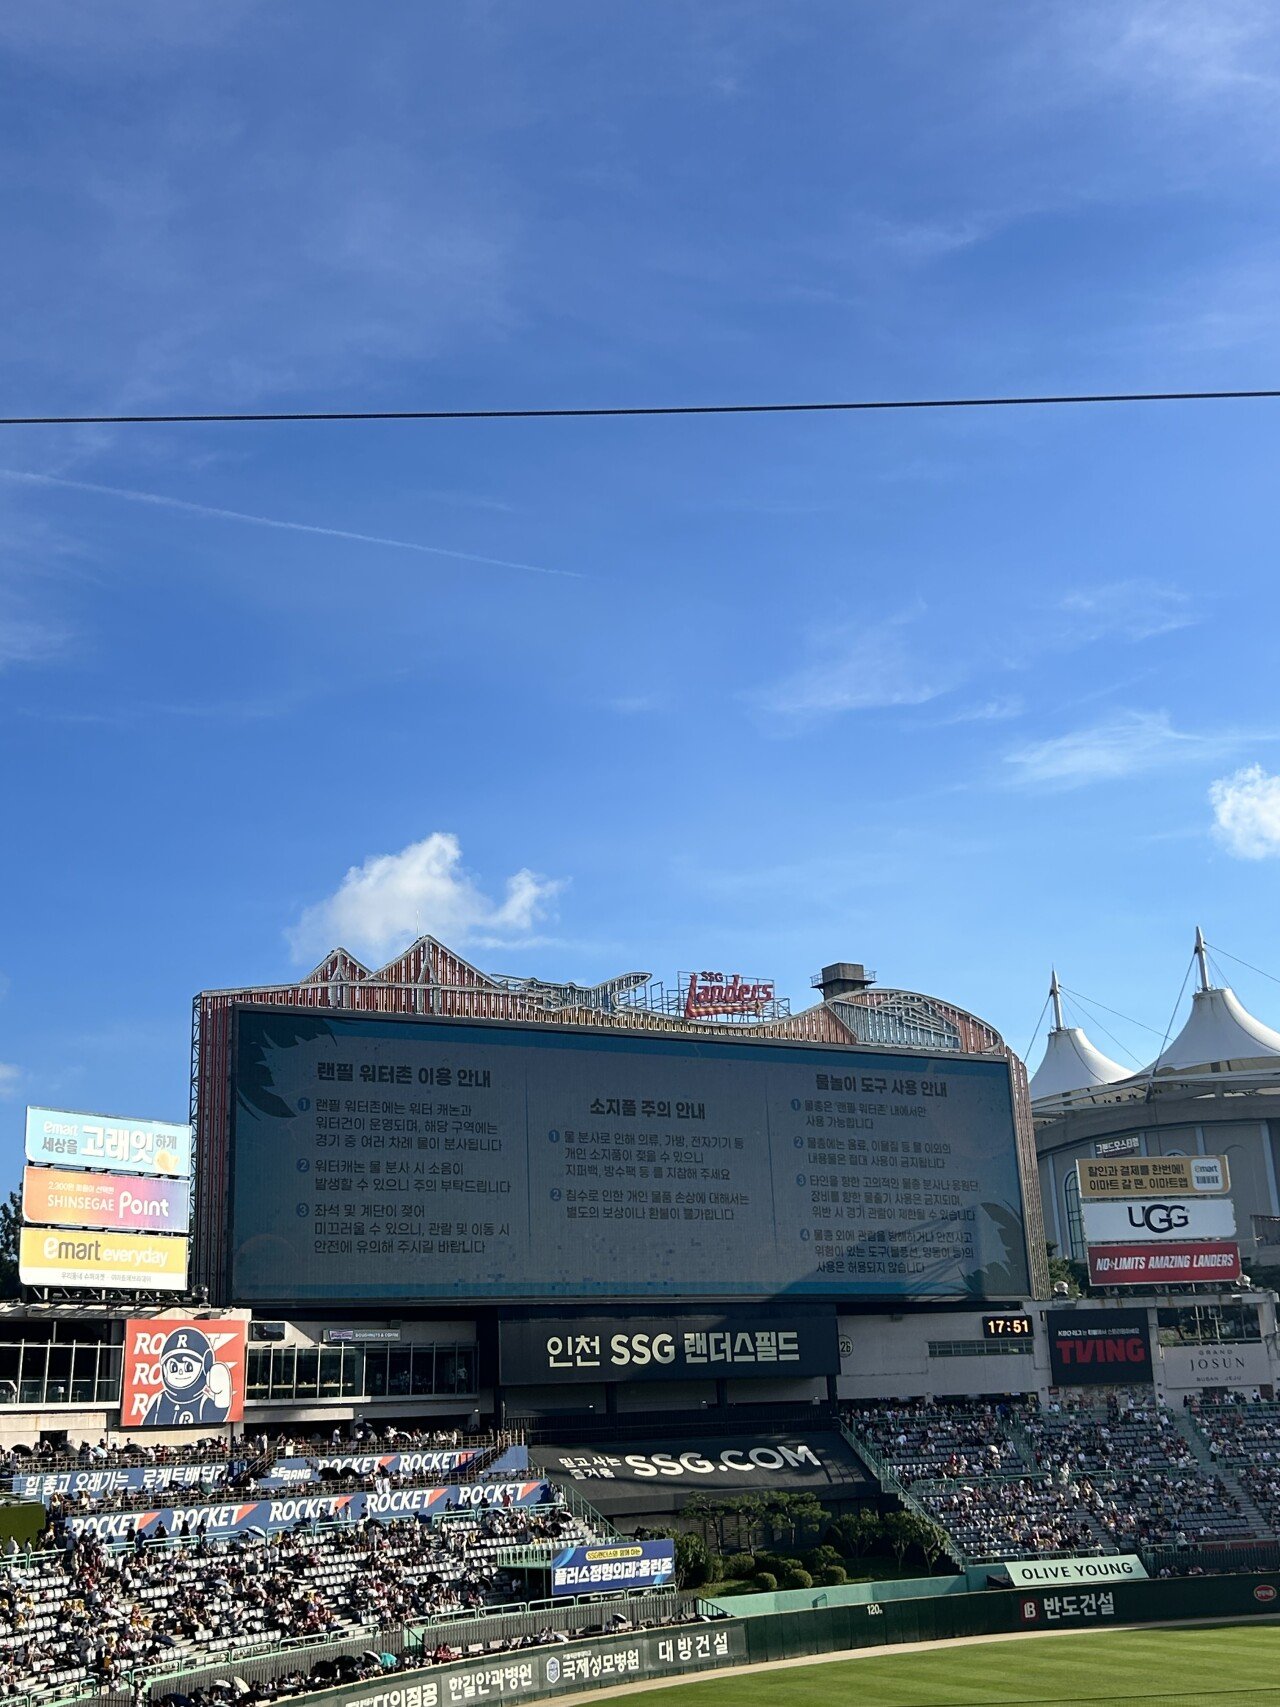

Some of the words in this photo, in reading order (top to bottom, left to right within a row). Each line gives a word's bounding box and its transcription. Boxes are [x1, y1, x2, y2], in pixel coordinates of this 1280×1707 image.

[701, 971, 723, 982] SSG
[684, 973, 774, 1018] Landers
[317, 1062, 353, 1082] 랜필
[418, 1067, 452, 1087] 이용
[457, 1069, 491, 1088] 안내
[816, 1074, 857, 1092] 물놀이
[861, 1077, 887, 1093] 도구
[892, 1079, 917, 1095] 사용
[921, 1081, 948, 1097] 안내
[316, 1099, 340, 1112] 랜필
[344, 1100, 405, 1115] 워터존에는
[409, 1102, 433, 1116] 워터
[437, 1103, 471, 1117] 캐논과
[590, 1098, 636, 1117] 소지품
[641, 1100, 670, 1118] 주의
[676, 1102, 706, 1120] 안내
[890, 1105, 926, 1117] 내에서만
[44, 1121, 79, 1137] emart
[316, 1116, 365, 1131] 워터건이
[369, 1118, 421, 1133] 운영되며,
[425, 1120, 448, 1134] 해당
[452, 1121, 498, 1135] 구역에는
[806, 1115, 824, 1127] 사용
[828, 1116, 873, 1129] 가능합니다
[42, 1137, 78, 1155] 세상을
[316, 1134, 339, 1148] 경기
[345, 1135, 356, 1148] 중
[361, 1135, 384, 1149] 여러
[388, 1136, 412, 1149] 차례
[417, 1137, 440, 1151] 물이
[444, 1138, 502, 1152] 분사됩니다
[565, 1131, 575, 1143] 물
[578, 1132, 611, 1144] 분사로
[614, 1132, 635, 1145] 인해
[691, 1136, 731, 1149] 전자기기
[565, 1147, 587, 1160] 개인
[589, 1148, 632, 1162] 소지품이
[636, 1150, 656, 1162] 젖을
[660, 1151, 670, 1163] 수
[673, 1151, 704, 1164] 있으니
[870, 1155, 897, 1168] 사용이
[900, 1156, 945, 1169] 금지됩니다
[315, 1159, 365, 1173] 워터캐논
[369, 1160, 381, 1173] 물
[386, 1161, 408, 1174] 분사
[414, 1162, 424, 1175] 시
[429, 1162, 464, 1175] 소음이
[604, 1165, 636, 1178] 방수팩
[667, 1167, 697, 1179] 지참해
[700, 1168, 730, 1180] 주세요
[1088, 1165, 1118, 1178] 할인과
[1120, 1164, 1149, 1177] 결제를
[315, 1177, 352, 1191] 발생할
[356, 1179, 368, 1191] 수
[373, 1178, 408, 1192] 있으니
[414, 1179, 437, 1192] 주의
[441, 1180, 511, 1194] 부탁드립니다
[863, 1177, 899, 1189] 고의적인
[1089, 1179, 1120, 1191] 이마트
[1122, 1178, 1132, 1190] 갈
[1149, 1177, 1188, 1190] 이마트앱
[48, 1194, 114, 1211] SHINSEGAE
[119, 1191, 169, 1219] Point
[566, 1189, 599, 1202] 침수로
[602, 1190, 623, 1202] 인한
[627, 1190, 648, 1203] 개인
[675, 1192, 705, 1204] 손상에
[709, 1193, 750, 1206] 대해서는
[895, 1193, 923, 1205] 사용은
[315, 1204, 339, 1217] 좌석
[344, 1204, 355, 1217] 및
[360, 1205, 396, 1218] 계단이
[401, 1205, 425, 1218] 젖어
[566, 1206, 599, 1218] 별도의
[603, 1206, 645, 1219] 보상이나
[649, 1207, 680, 1220] 환불이
[684, 1208, 734, 1221] 불가합니다
[812, 1207, 831, 1218] 위반
[847, 1208, 865, 1219] 경기
[868, 1208, 895, 1220] 관람이
[940, 1210, 975, 1222] 있습니다
[1128, 1204, 1189, 1233] UGG
[315, 1221, 365, 1235] 미끄러울
[369, 1222, 380, 1235] 수
[429, 1223, 452, 1236] 관람
[456, 1223, 468, 1236] 및
[472, 1223, 494, 1236] 이동
[499, 1223, 510, 1236] 시
[44, 1236, 101, 1261] emart
[103, 1249, 168, 1267] everyday
[314, 1240, 352, 1254] 안전에
[357, 1240, 393, 1254] 유의해
[398, 1240, 434, 1254] 주시길
[438, 1240, 485, 1255] 바랍니다
[847, 1246, 866, 1257] 있는
[817, 1261, 845, 1273] 사용은
[848, 1261, 885, 1273] 허용되지
[888, 1262, 925, 1274] 않습니다
[1148, 1254, 1190, 1269] AMAZING
[1193, 1254, 1234, 1268] LANDERS
[988, 1319, 1029, 1334] 17:51
[176, 1334, 188, 1347] R
[547, 1334, 600, 1367] 인천
[610, 1333, 675, 1365] SSG
[684, 1331, 800, 1363] 랜더스필드
[1056, 1337, 1145, 1364] TVING
[1190, 1357, 1245, 1371] JOSUN
[399, 1452, 463, 1473] ROCKET
[559, 1457, 591, 1468] 믿고
[592, 1455, 622, 1468] 사는
[624, 1445, 822, 1477] SSG.COM
[270, 1467, 312, 1481] SEBANG
[25, 1475, 40, 1496] 힘
[43, 1473, 71, 1495] 좋고
[366, 1489, 435, 1513] ROCKET
[459, 1483, 526, 1506] ROCKET
[170, 1505, 244, 1532] ROCKET
[269, 1498, 341, 1522] ROCKET
[1021, 1566, 1071, 1580] OLIVE
[1074, 1562, 1133, 1577] YOUNG
[1044, 1592, 1115, 1619] 반도건설
[659, 1631, 728, 1663] 대방건설
[562, 1649, 640, 1681] 국제성모병원
[449, 1663, 532, 1701] 한길안과병원
